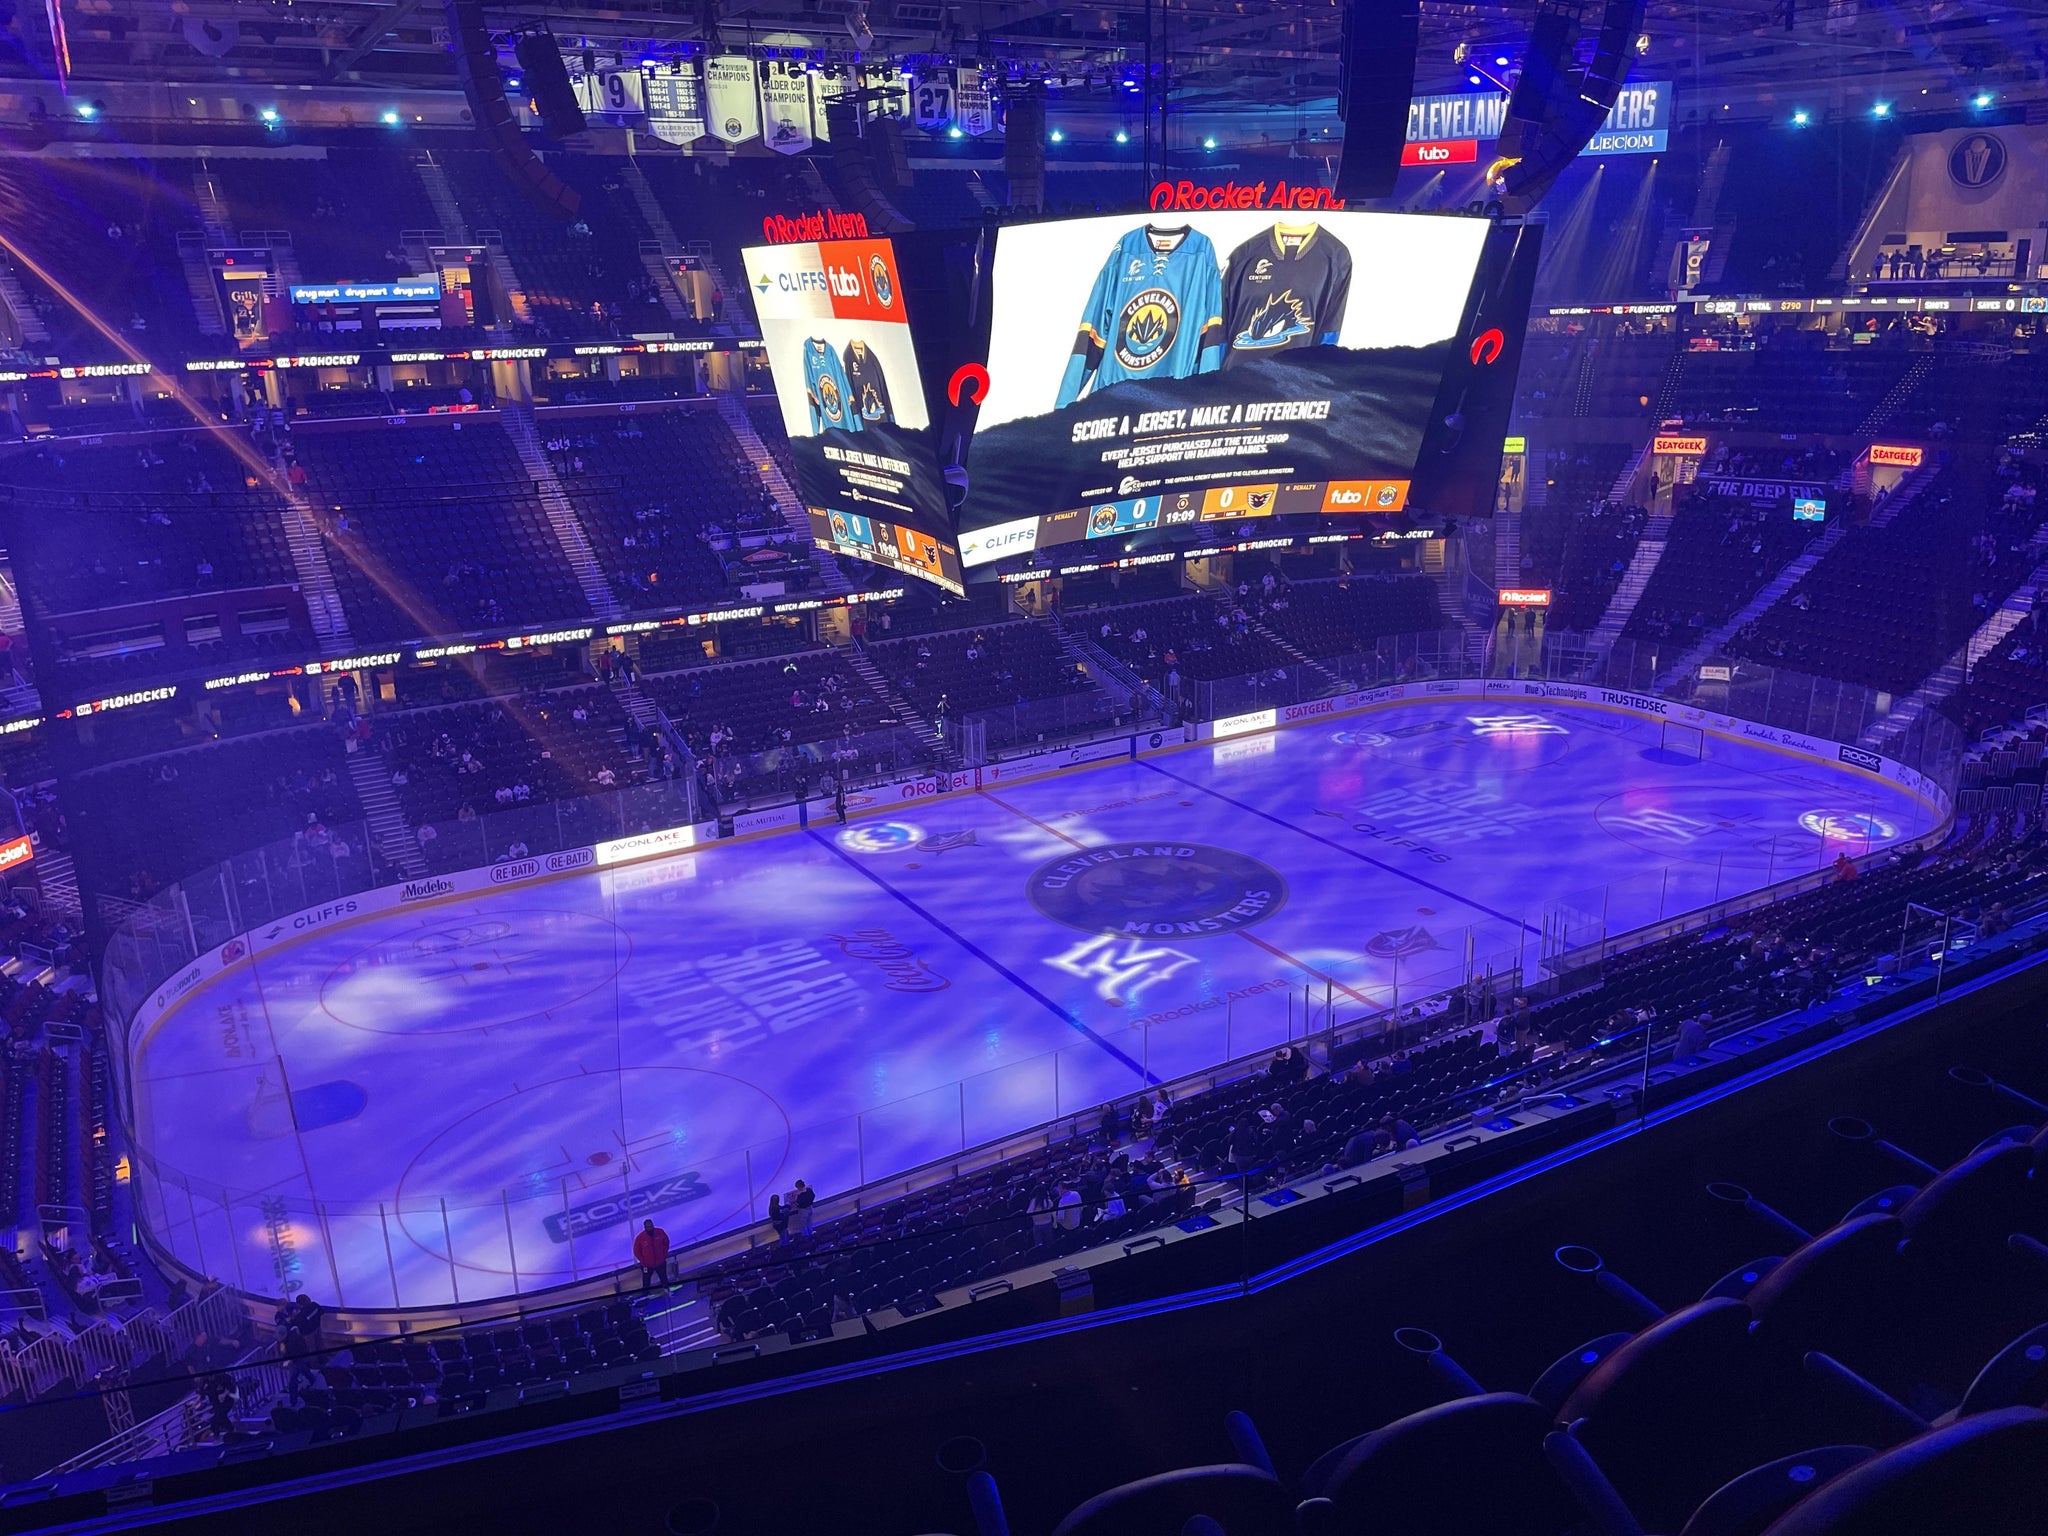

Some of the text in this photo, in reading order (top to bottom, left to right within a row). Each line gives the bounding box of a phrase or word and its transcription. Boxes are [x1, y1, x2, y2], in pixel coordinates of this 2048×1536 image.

[708, 71, 750, 82] CHAMPIONS
[762, 80, 805, 91] CALDER CUP
[609, 75, 625, 108] 9
[763, 92, 806, 103] CHAMPIONS
[920, 87, 949, 119] 27
[1418, 145, 1449, 160] fubo
[1174, 181, 1266, 210] Rocket
[774, 208, 868, 243] Rocket Arena
[778, 271, 827, 292] CLIFFS
[829, 265, 860, 297] fubo
[295, 286, 435, 300] drug mart drug mart drug mart
[1127, 292, 1176, 316] CLEVELAND
[1629, 305, 1677, 314] FLOHOCKEY
[1748, 301, 1802, 311] TOTAL $790
[2005, 300, 2015, 310] 0
[391, 353, 417, 362] WATCH
[491, 348, 547, 359] FLOHOCKEY
[664, 341, 714, 352] FLOHOCKEY
[1119, 346, 1164, 366] MONSTERS
[84, 363, 152, 377] FLOHOCKEY
[186, 361, 215, 370] WATCH
[298, 354, 361, 368] FLOHOCKEY
[1072, 400, 1331, 442] SCORE A JERSEY, MAKE A DIFFERENCE!
[1101, 433, 1290, 462] EVERY JERSEY PURCHASED AT THE TEAM SHOP
[1656, 440, 1703, 450] SEATGEEK
[1117, 456, 1145, 469] HELPS
[1144, 452, 1184, 465] SUPPORT
[1184, 450, 1197, 460] UH
[1197, 445, 1238, 459] RAINBOW
[1873, 449, 1917, 463] SEATGEEK
[1132, 479, 1161, 489] CENTURY
[1708, 480, 1739, 496] THE
[1741, 482, 1786, 499] DEEP
[1219, 487, 1234, 508] 0
[1331, 489, 1362, 504] fubo
[1132, 499, 1147, 520] 0
[1165, 509, 1196, 524] 19:09
[851, 516, 862, 536] 0
[905, 530, 916, 552] 0
[986, 528, 1035, 549] CLIFFS
[1251, 538, 1294, 549] FLOHOCKEY
[877, 541, 899, 559] 19:09
[1134, 552, 1175, 566] FLOHOCKEY
[1005, 569, 1051, 583] FLOHOCKEY
[774, 602, 798, 612] WATCH
[864, 588, 904, 602] FLOHOCK
[1511, 592, 1547, 603] Rocket
[606, 624, 632, 635] WATCH
[707, 606, 764, 622] FLOHOCKEY
[415, 647, 444, 659] WATCH
[529, 627, 592, 645] FLOHOCKEY
[205, 676, 235, 690] WATCH
[330, 652, 401, 672] FLOHOCKEY
[101, 686, 177, 711] FLOHOCKEY
[1524, 684, 1587, 700] Blue Technologies
[1285, 699, 1334, 721] SEATGEEK
[1600, 691, 1668, 715] TRUSTEDSEC
[1222, 713, 1268, 728] AVONLAKE
[916, 773, 968, 795] Rocket
[1075, 789, 1179, 817] Rocket Arena
[755, 814, 785, 827] MUTUAL
[610, 831, 681, 852] AVONLAKE
[1351, 823, 1452, 864] CLIFFS
[0, 841, 29, 865] cket
[1043, 845, 1197, 890] CLEVELAND
[405, 880, 448, 898] Modelo
[293, 901, 358, 929] CLIFFS
[1121, 889, 1272, 935] MONSTERS
[1224, 978, 1289, 1002] Arena
[1149, 996, 1222, 1025] Rocket
[558, 1177, 694, 1230] ROCK
